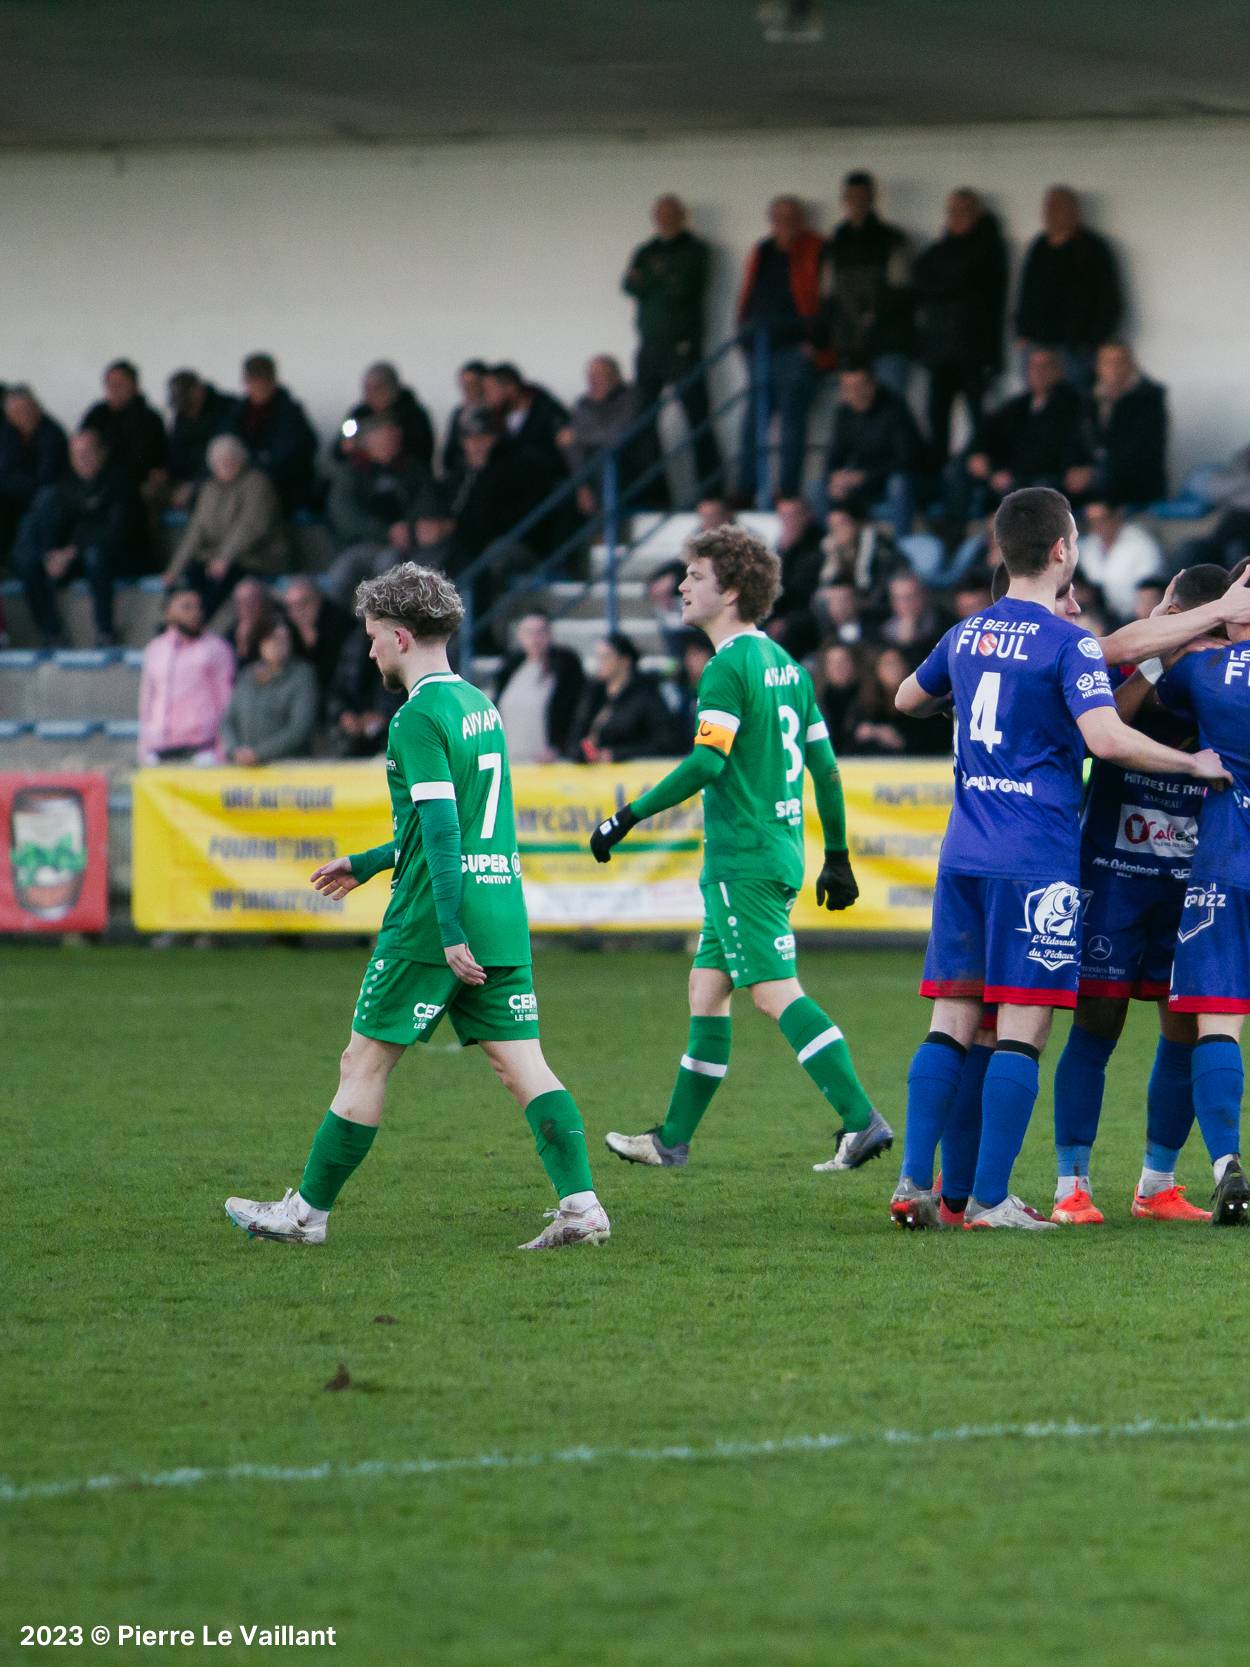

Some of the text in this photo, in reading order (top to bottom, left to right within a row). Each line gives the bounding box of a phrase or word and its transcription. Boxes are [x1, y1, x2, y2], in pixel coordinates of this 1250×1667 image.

[964, 616, 1040, 635] LE BELLER
[955, 630, 1029, 661] FIOUL
[1229, 649, 1250, 661] LE
[969, 671, 1003, 754] 4
[778, 704, 803, 783] 3
[477, 752, 502, 839] 7
[460, 854, 511, 873] SUPER
[1028, 948, 1042, 957] du
